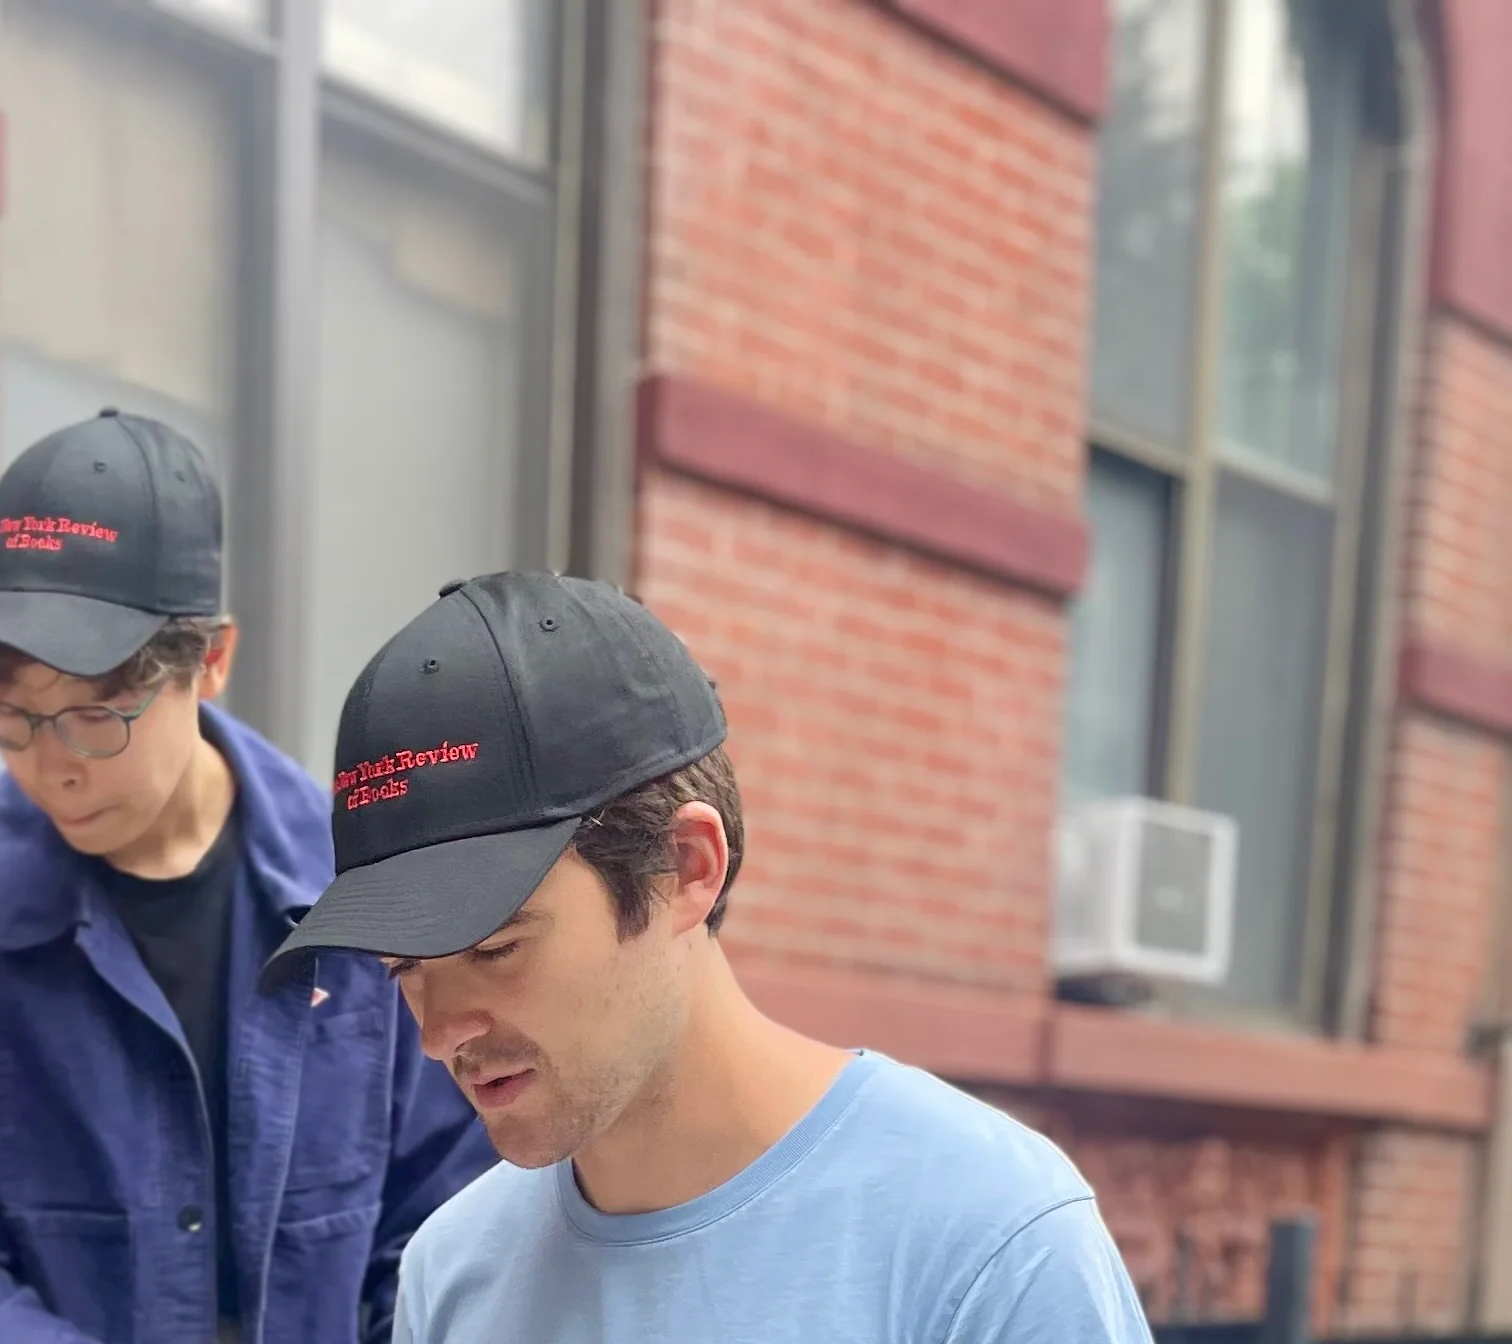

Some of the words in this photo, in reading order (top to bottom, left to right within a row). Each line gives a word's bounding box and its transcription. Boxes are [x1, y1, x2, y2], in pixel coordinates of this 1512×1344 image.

[5, 533, 19, 548] of
[18, 534, 63, 550] Books
[23, 516, 56, 531] York
[56, 517, 118, 542] Review
[357, 755, 396, 782] York
[396, 740, 479, 771] Review
[356, 778, 408, 805] Books
